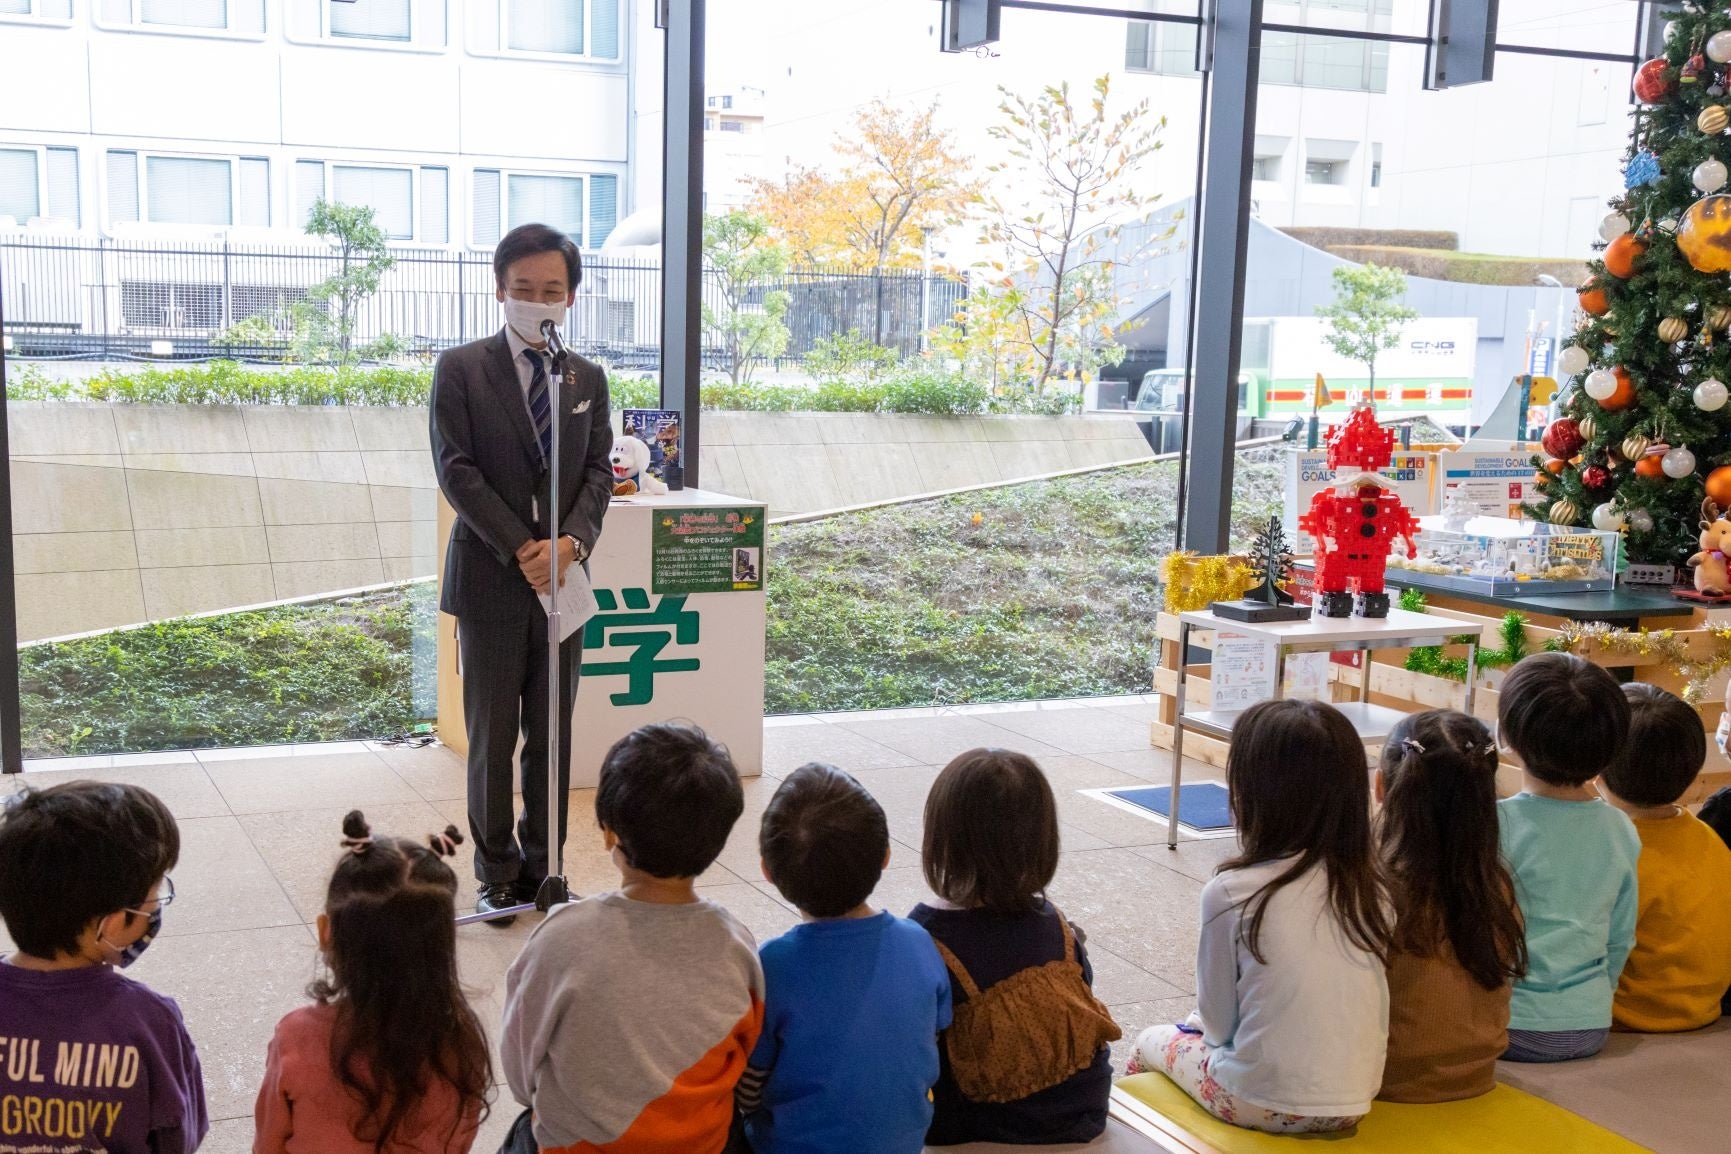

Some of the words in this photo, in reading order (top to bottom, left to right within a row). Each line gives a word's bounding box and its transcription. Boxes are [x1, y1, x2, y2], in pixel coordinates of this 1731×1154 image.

[624, 414, 679, 430] 科学
[1505, 458, 1528, 467] GOAL
[1301, 471, 1337, 481] GOALS
[1470, 469, 1536, 477] 世界を変えるための17の目
[580, 588, 701, 706] 学
[54, 1041, 140, 1089] MIND
[2, 1094, 123, 1139] GROOVY
